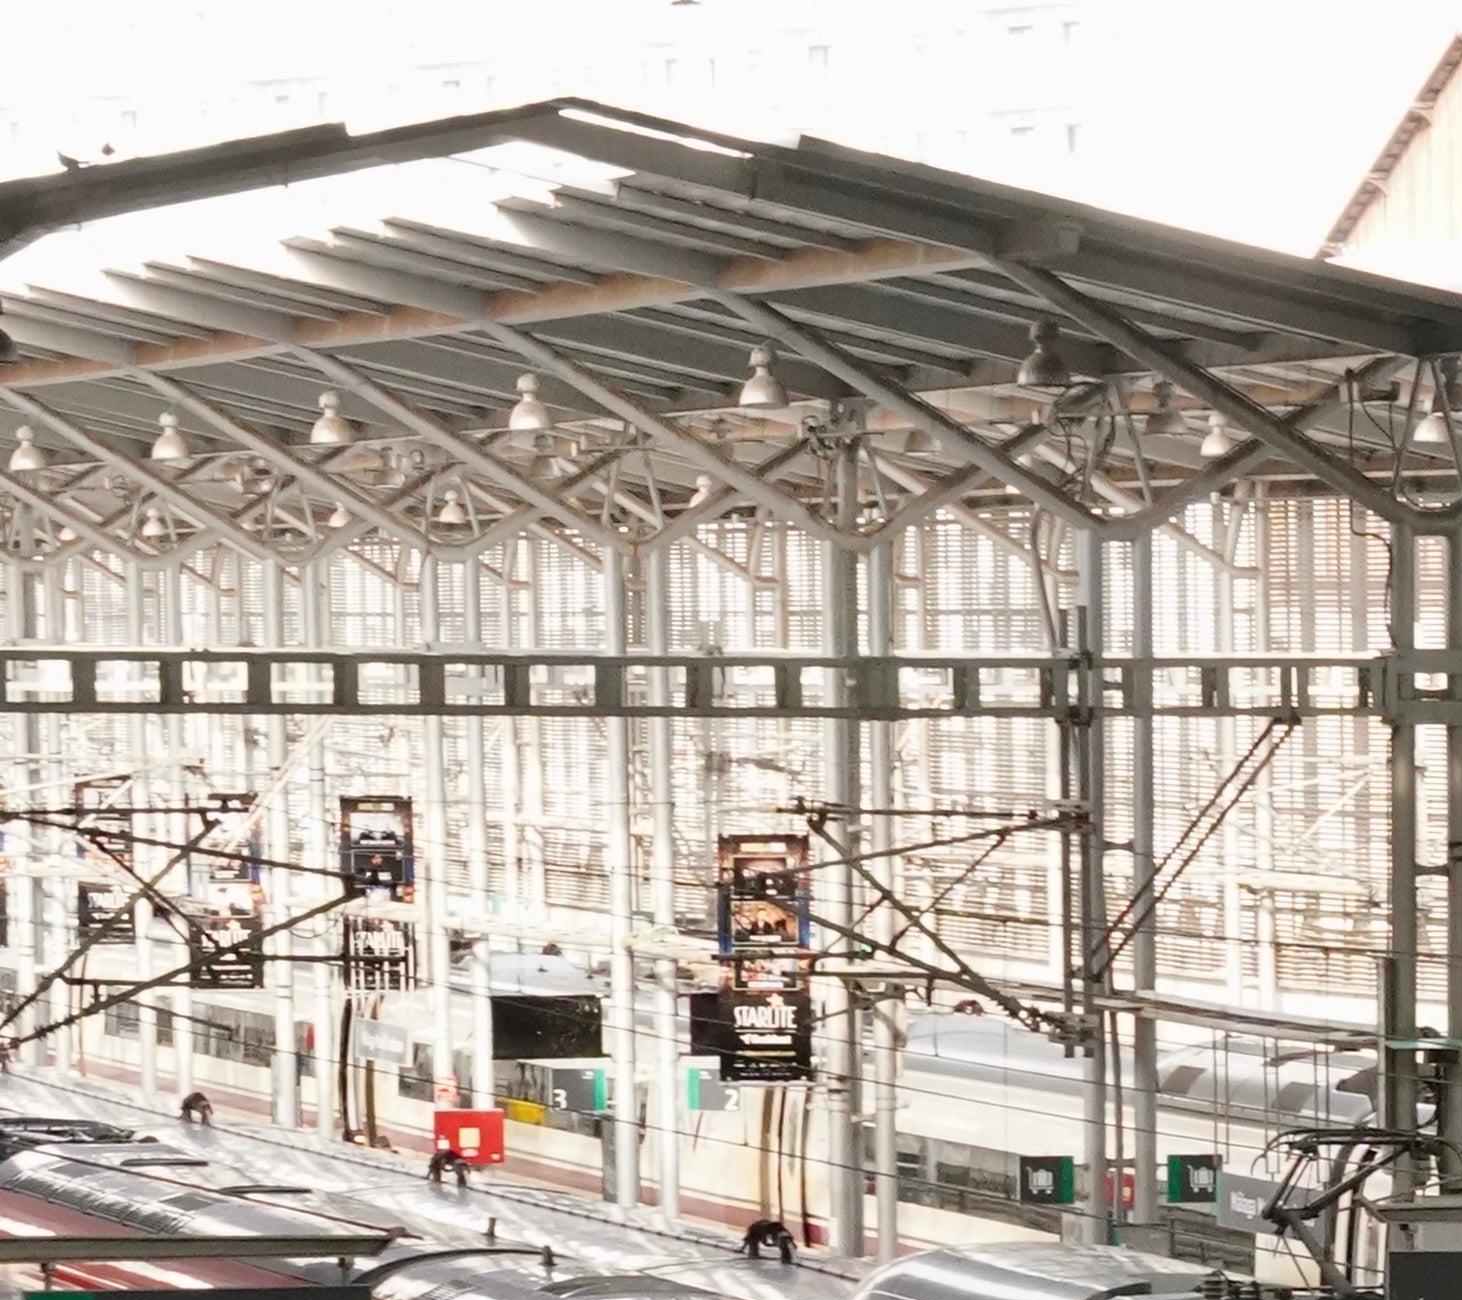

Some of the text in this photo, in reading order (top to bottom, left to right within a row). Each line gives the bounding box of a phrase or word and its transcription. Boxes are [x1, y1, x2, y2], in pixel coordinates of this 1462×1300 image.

[734, 1006, 798, 1028] STARLITE
[553, 1089, 567, 1109] 3
[724, 1088, 739, 1111] 2
